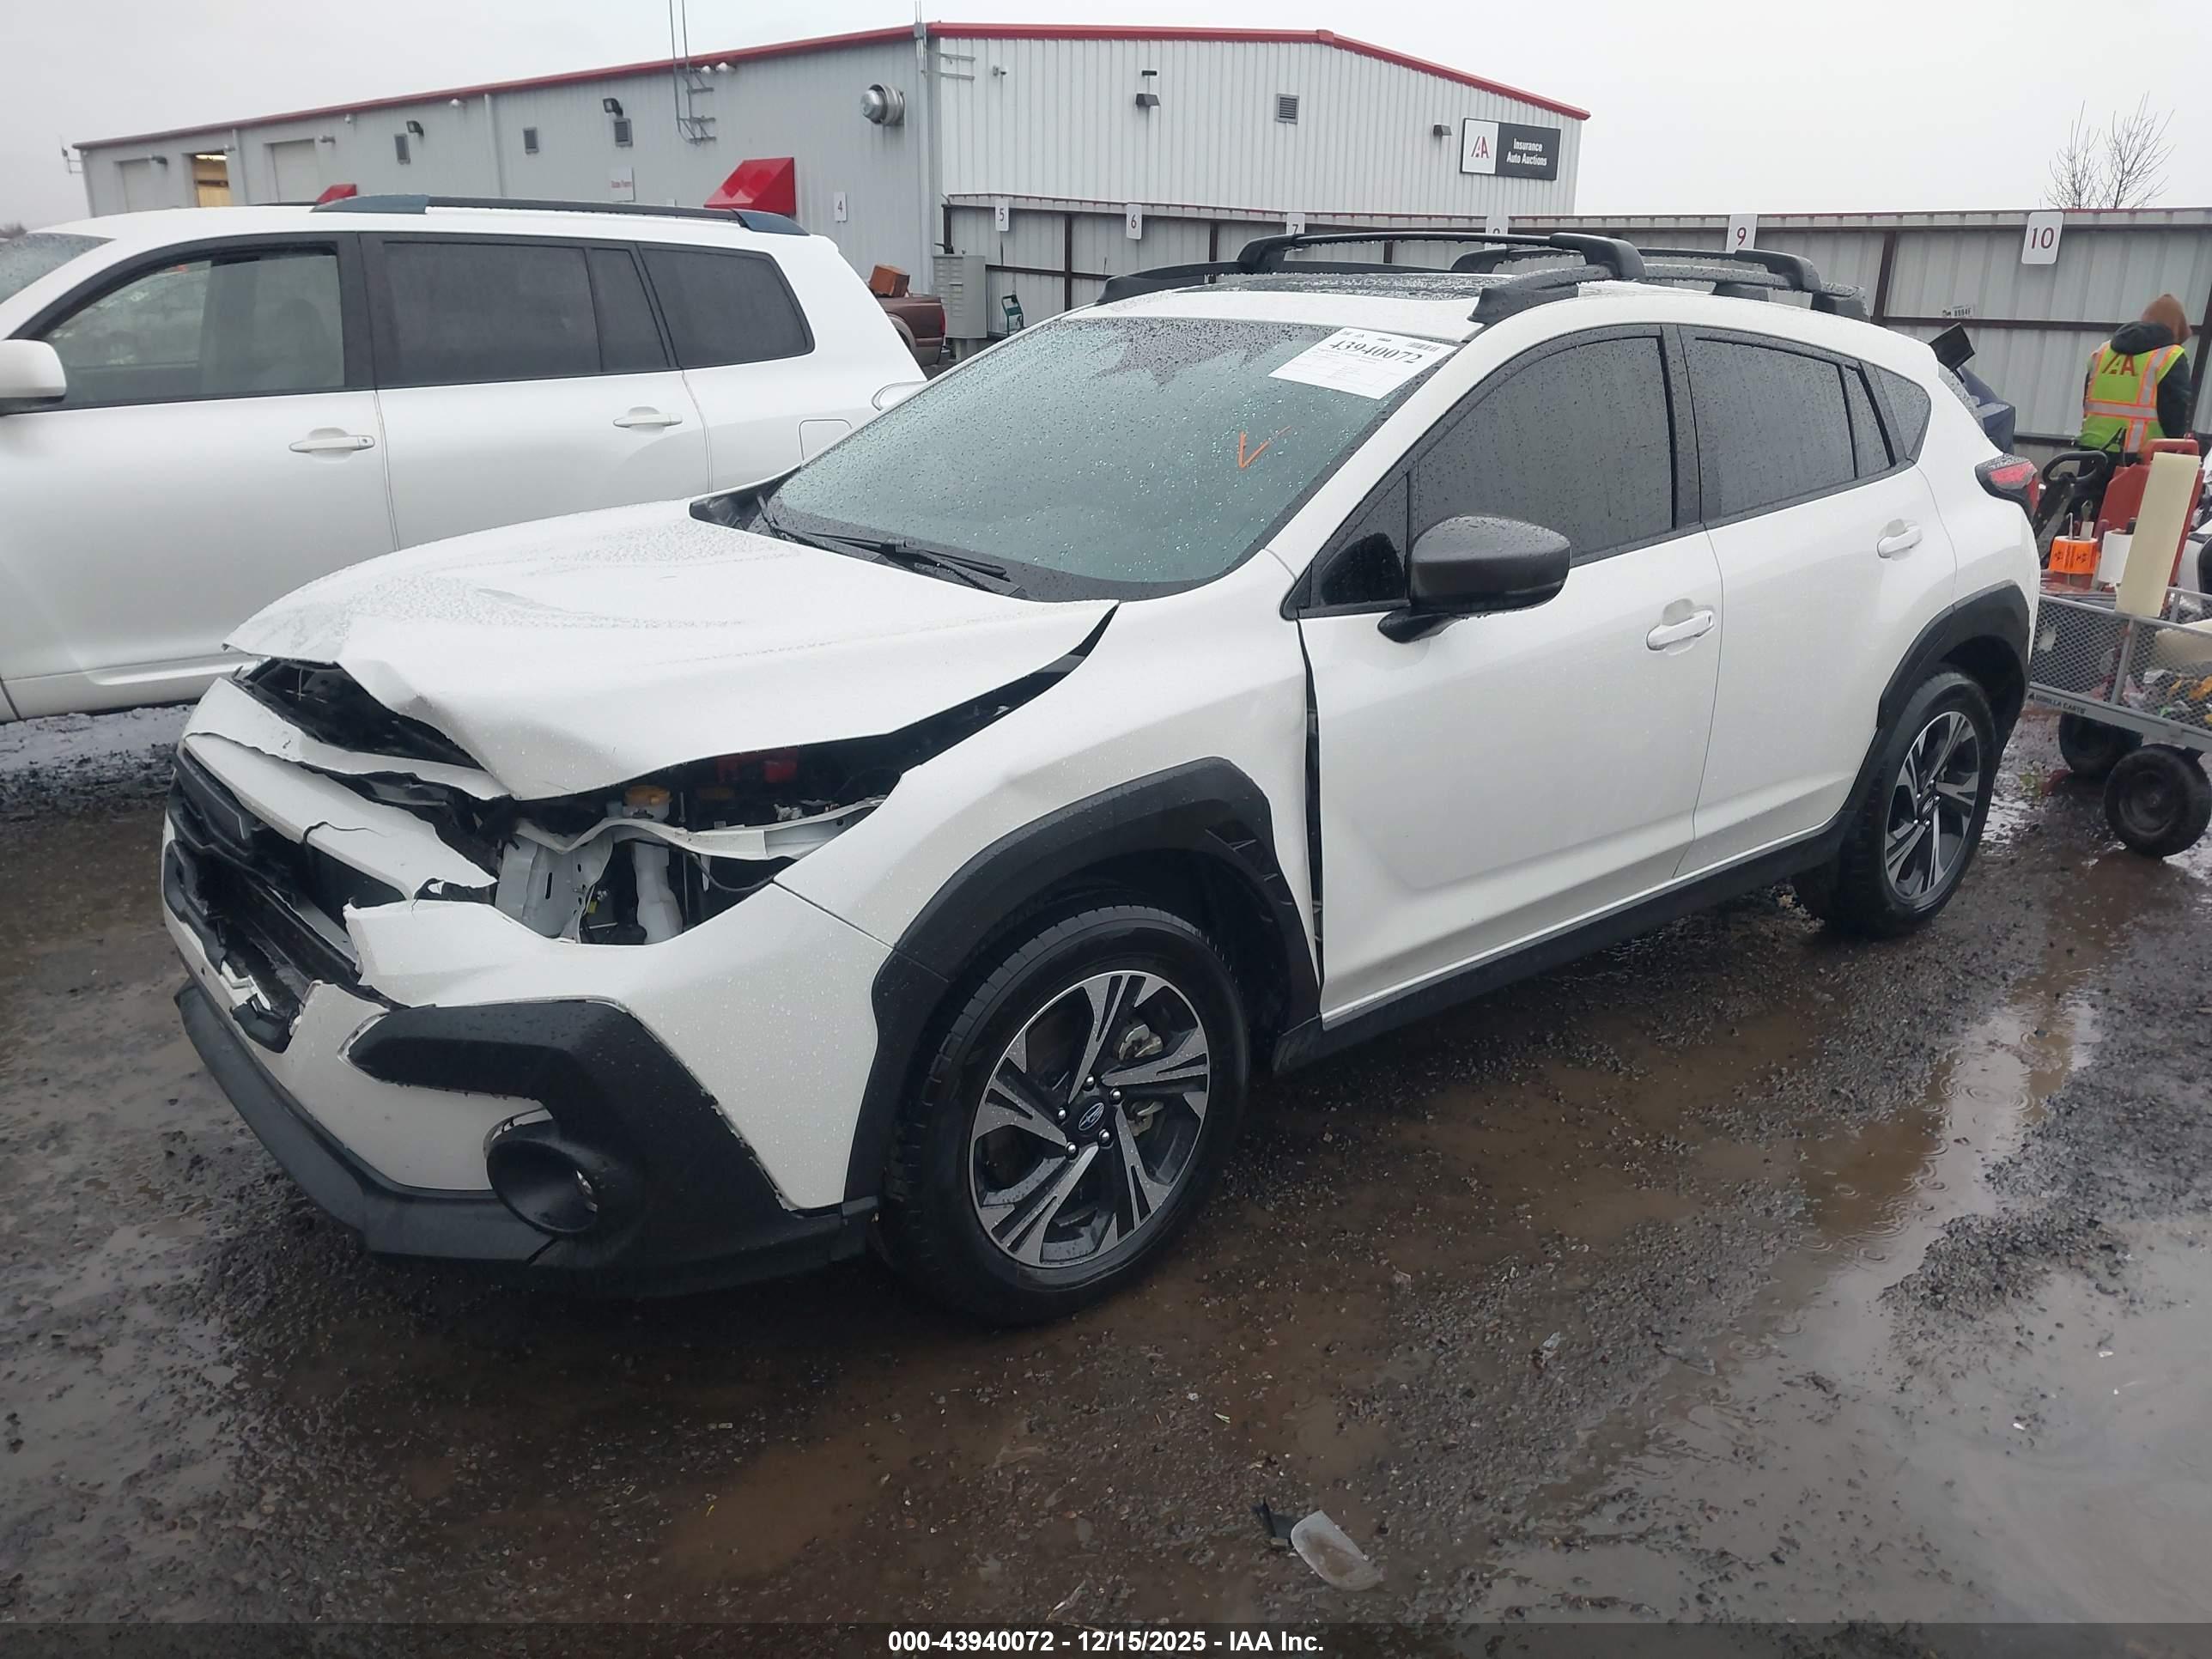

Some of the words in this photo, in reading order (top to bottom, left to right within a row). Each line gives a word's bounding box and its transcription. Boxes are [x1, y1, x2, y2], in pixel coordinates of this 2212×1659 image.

[1514, 137, 1543, 152] Insurance
[1506, 151, 1521, 164] Auto
[1521, 153, 1547, 167] Auctions
[837, 200, 843, 214] 4
[999, 207, 1005, 222] 5
[1130, 214, 1137, 229] 6
[1291, 223, 1299, 234] 7
[1736, 226, 1747, 246] 9
[2031, 227, 2055, 249] 10
[1329, 339, 1423, 364] 43940072
